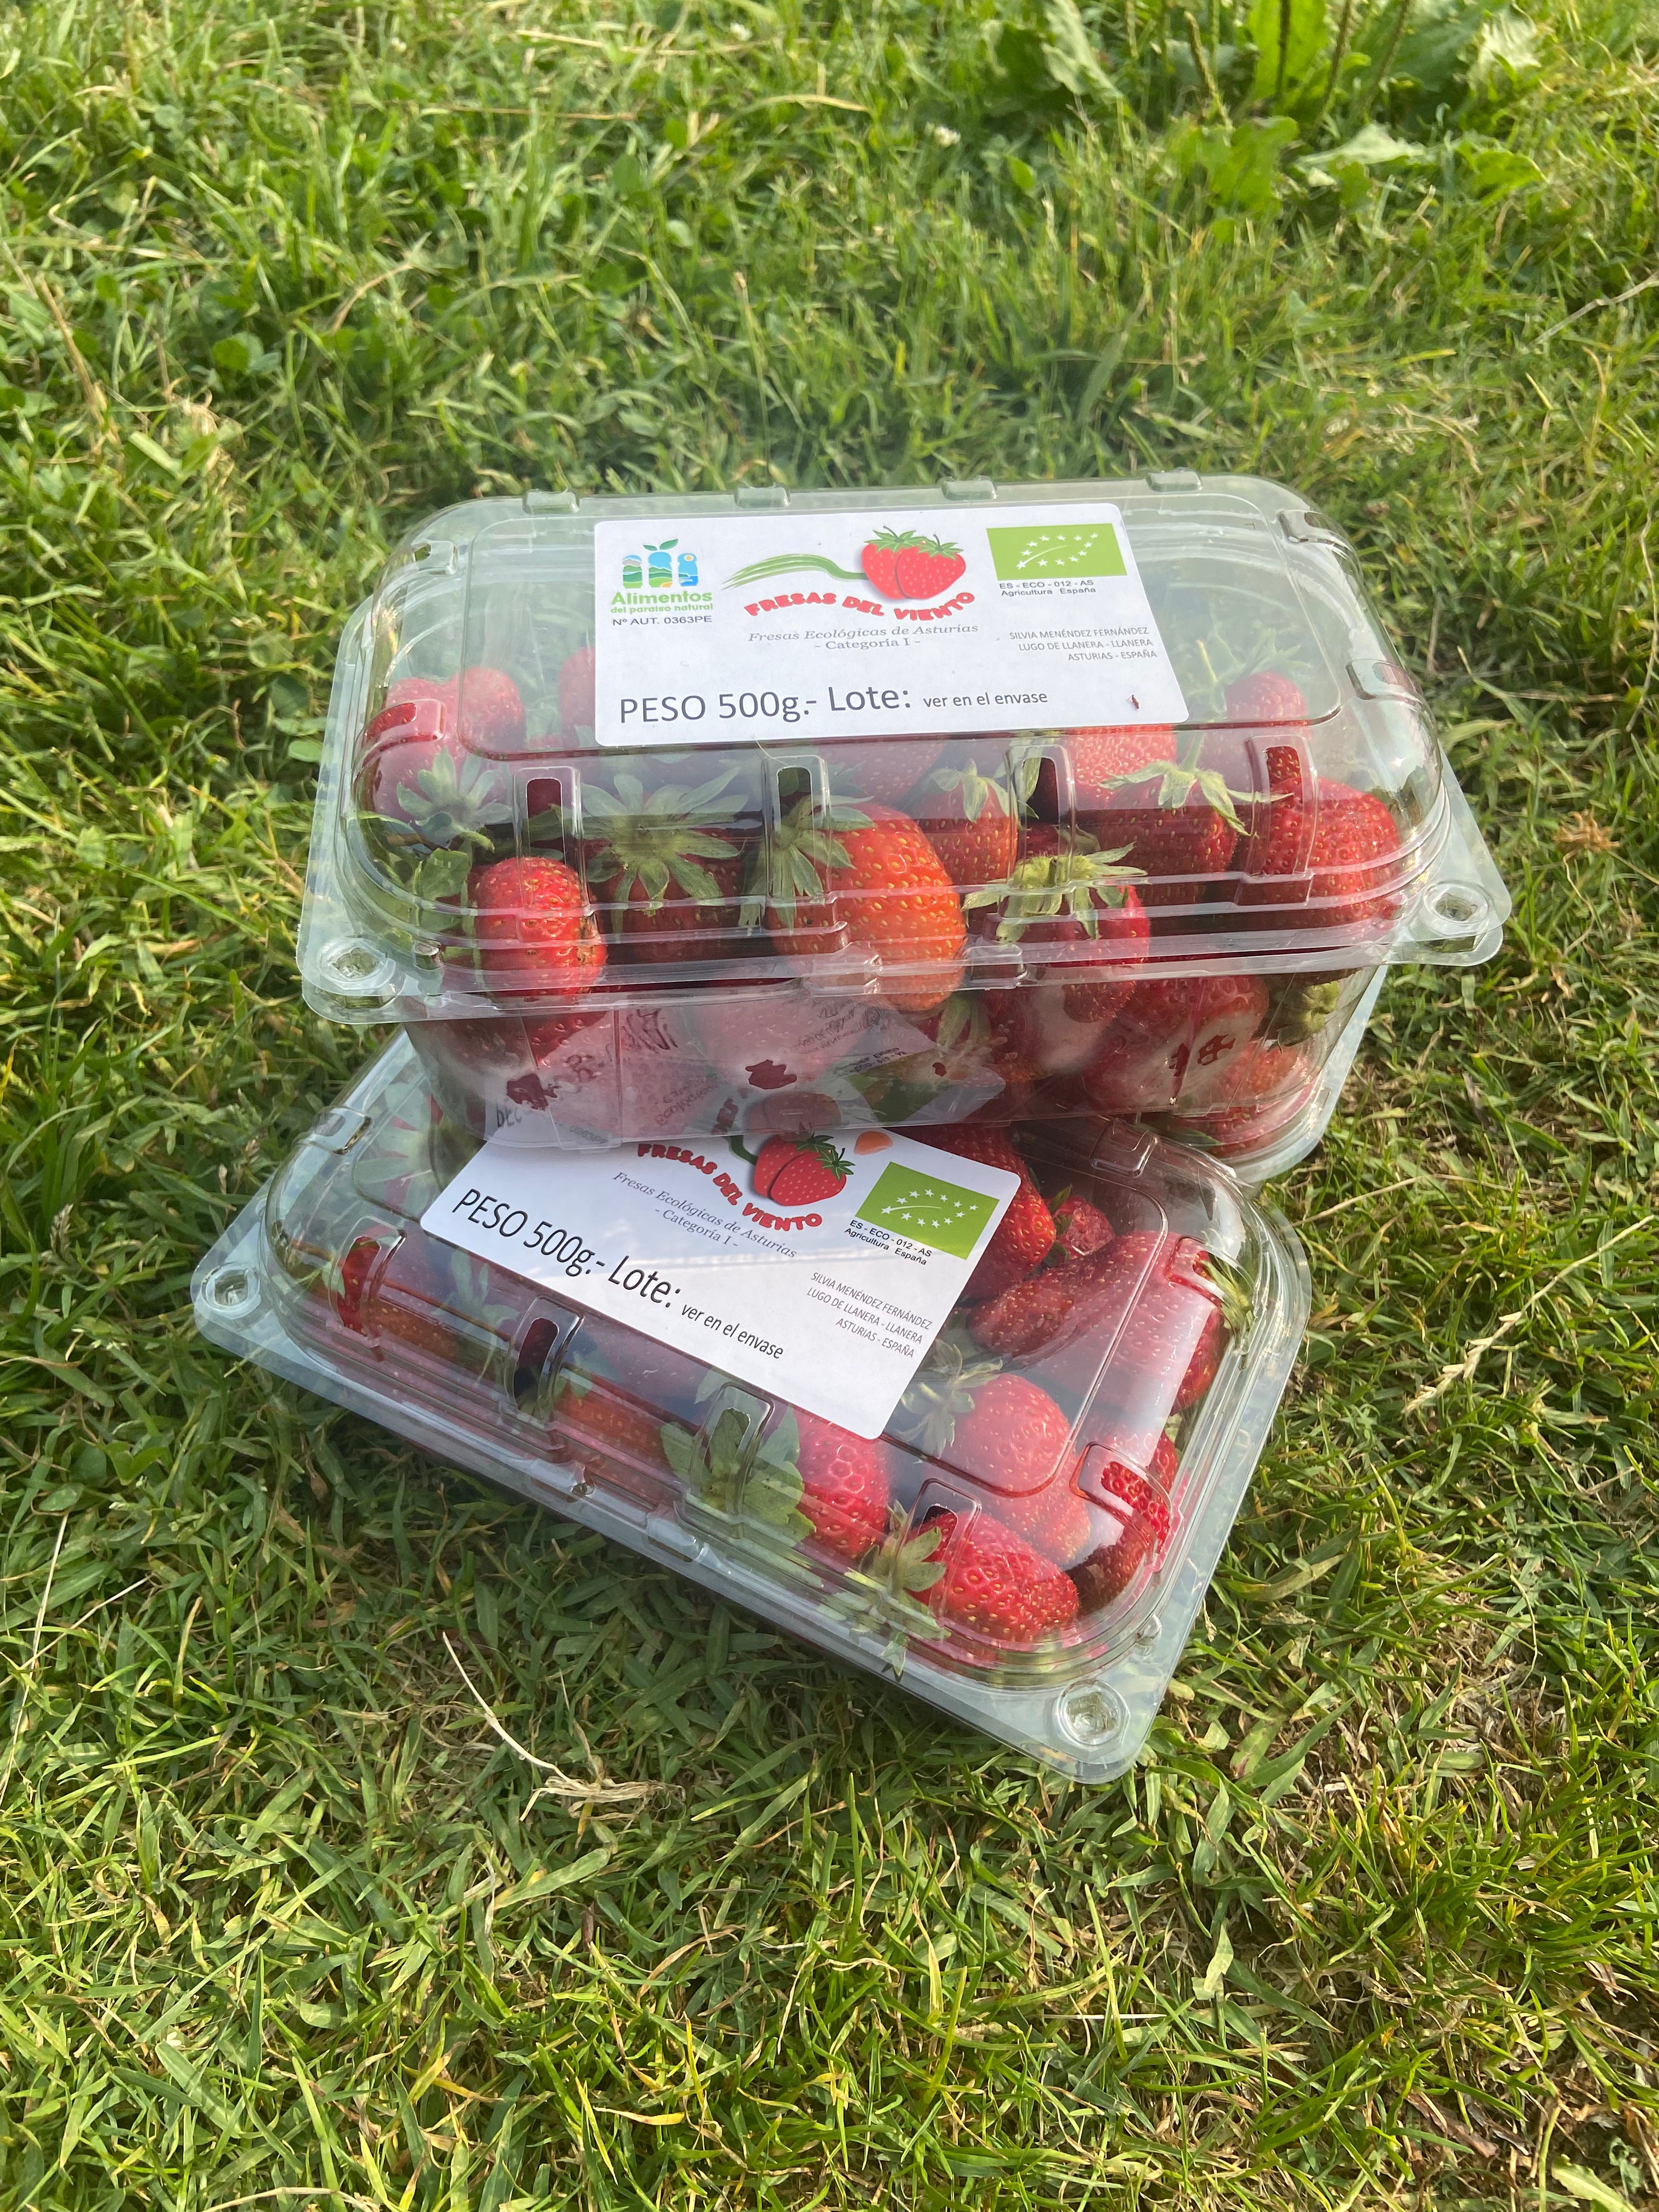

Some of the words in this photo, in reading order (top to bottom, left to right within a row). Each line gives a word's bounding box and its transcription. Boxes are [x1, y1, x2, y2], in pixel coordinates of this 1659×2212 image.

[611, 591, 712, 605] Alimentos
[744, 592, 837, 617] FRESAS
[842, 596, 884, 617] DEL
[894, 592, 975, 620] VIENTO
[1001, 589, 1052, 597] Agricultura
[664, 616, 713, 624] 0363PE
[748, 632, 799, 641] Fresas
[804, 628, 886, 639] Ecológicas
[891, 626, 909, 635] de
[912, 624, 978, 634] Asturias
[1040, 629, 1091, 638] MENÉNDEZ
[1094, 627, 1149, 636] FERNÁNDEZ
[826, 639, 899, 650] Categoría
[904, 637, 910, 646] I
[1062, 641, 1103, 649] LLANERA
[1111, 639, 1153, 647] LLANERA
[1068, 652, 1113, 661] ASTURIAS
[1121, 650, 1157, 659] ESPAÑA
[621, 695, 706, 723] PESO
[828, 686, 911, 711] Lote:
[922, 696, 947, 708] ver
[953, 695, 972, 706] en
[977, 692, 990, 705] el
[995, 692, 1048, 704] envase
[637, 1143, 718, 1175] FRESAS
[713, 1172, 743, 1205] DEL
[742, 1202, 822, 1232] VIENTO
[612, 1172, 656, 1196] Fresas
[654, 1190, 724, 1226] Ecológicas
[724, 1221, 741, 1234] de
[740, 1228, 797, 1258] Asturias
[663, 1210, 721, 1240] Categoría
[723, 1235, 732, 1245] I
[844, 1228, 889, 1250] Agricultura
[895, 1248, 927, 1265] España
[850, 1220, 863, 1229] ES
[869, 1228, 890, 1240] ECO
[896, 1239, 912, 1250] 012
[918, 1248, 932, 1257] AS
[453, 1188, 528, 1238] PESO
[608, 1255, 680, 1308] Lote:
[681, 1304, 704, 1321] ver
[704, 1315, 722, 1330] en
[723, 1323, 740, 1338] el
[737, 1330, 783, 1359] envase
[807, 1288, 831, 1303] LUGO
[831, 1298, 845, 1309] DE
[843, 1304, 880, 1325] LLANERA
[885, 1322, 922, 1344] LLANERA
[811, 1272, 836, 1288] SILVIA
[836, 1283, 883, 1309] MENÉNDEZ
[882, 1304, 932, 1330] FERNÁNDEZ
[836, 1318, 877, 1341] ASTURIAS
[882, 1338, 915, 1358] ESPAÑA
